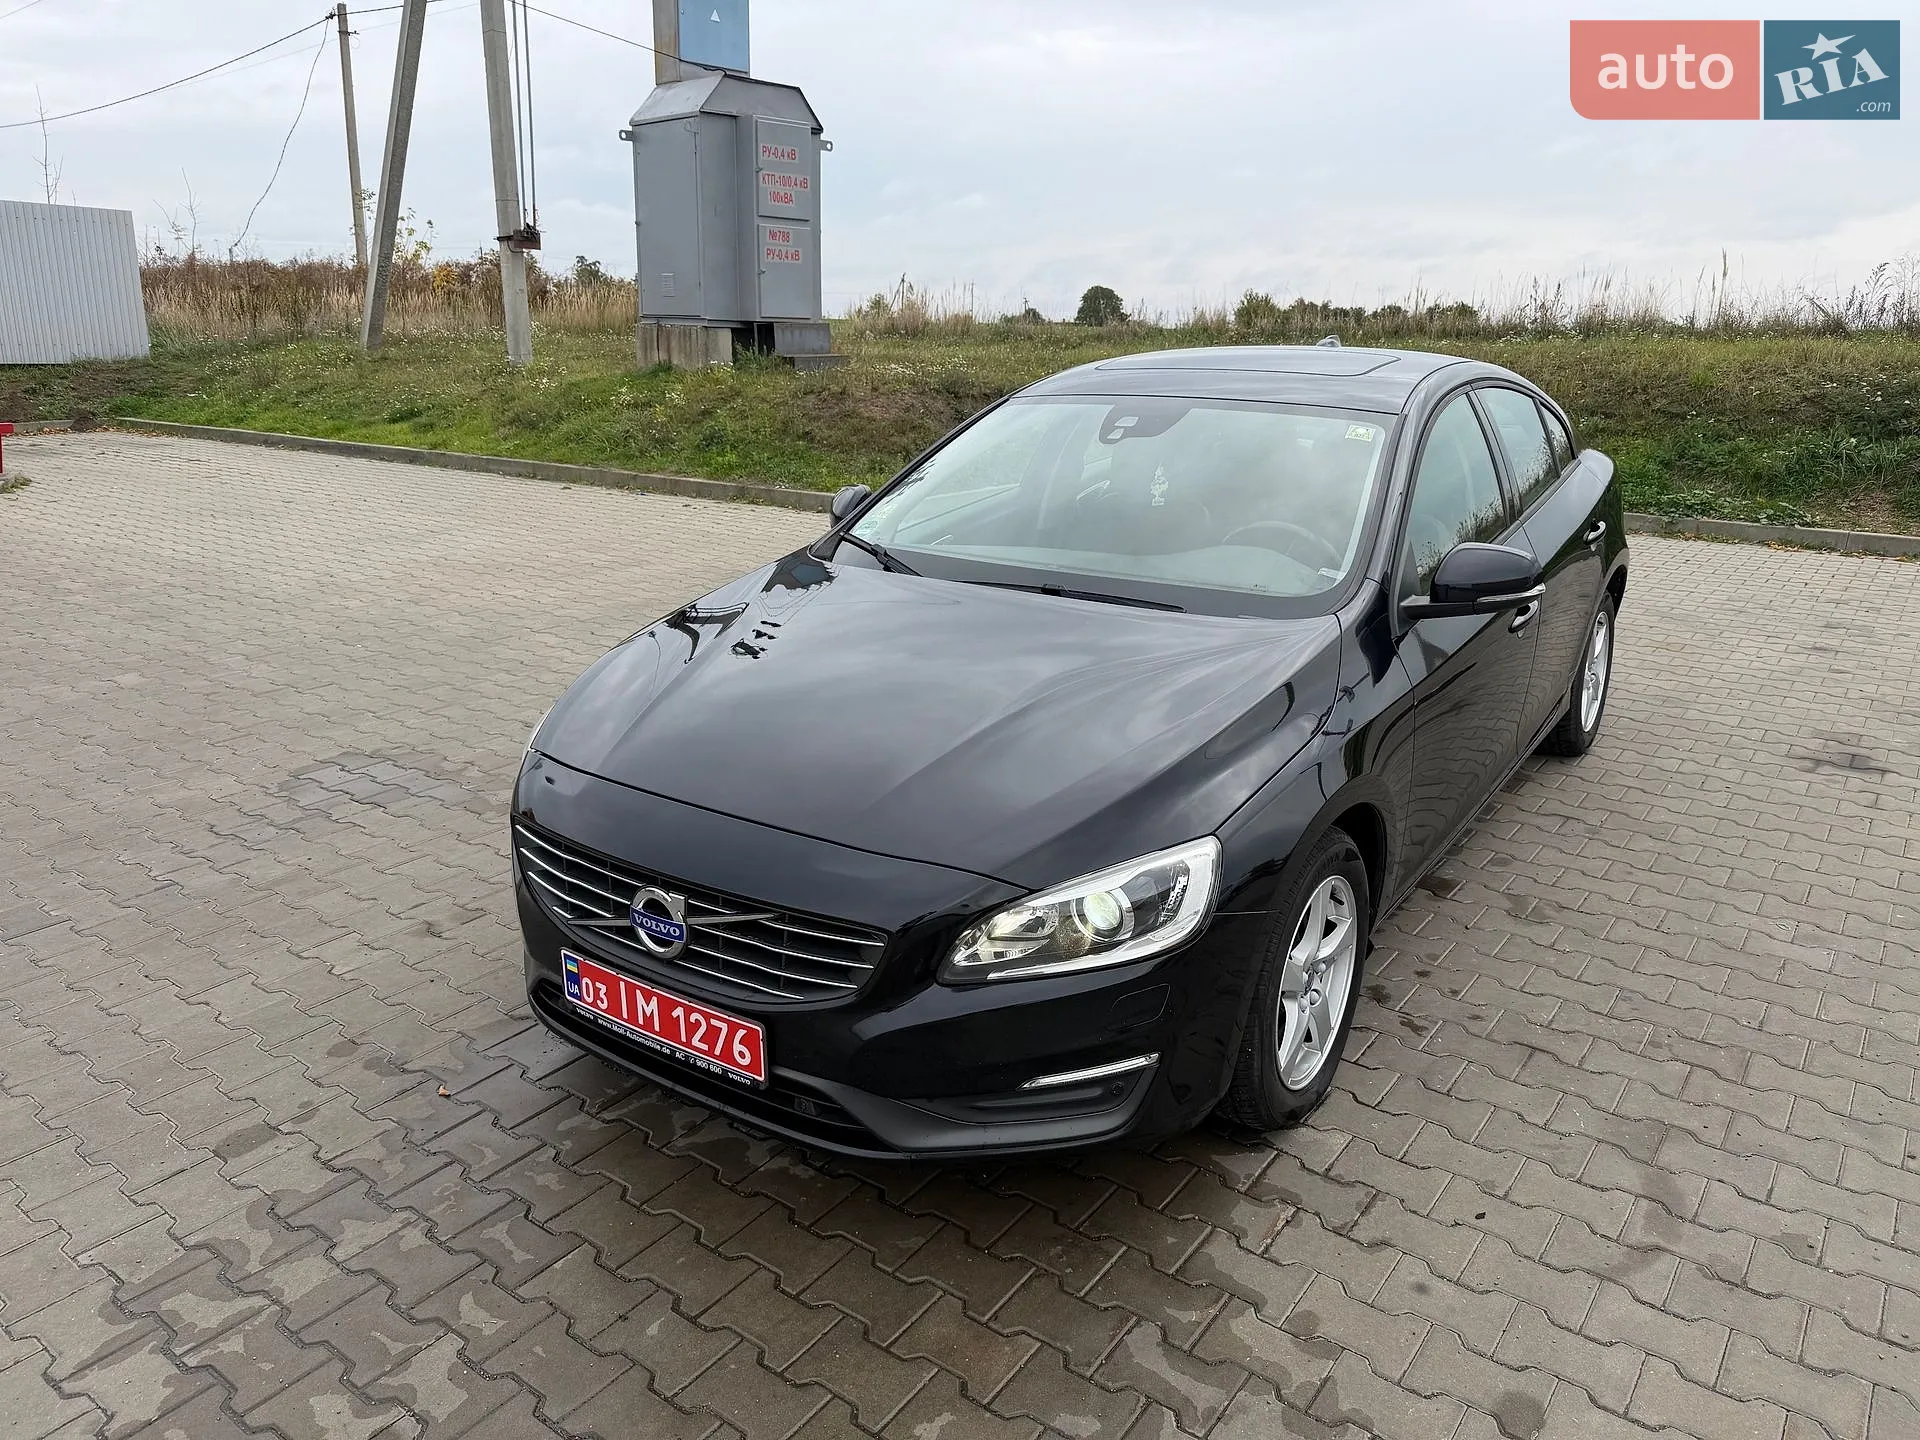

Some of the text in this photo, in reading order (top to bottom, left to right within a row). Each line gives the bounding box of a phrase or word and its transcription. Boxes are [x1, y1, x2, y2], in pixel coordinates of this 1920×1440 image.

[762, 145, 785, 160] РУ-0,4
[766, 248, 789, 263] РУ-0,4
[633, 912, 680, 936] VOLVO
[568, 981, 580, 996] UA
[582, 977, 752, 1066] 03 IM 1276
[728, 1072, 751, 1085] VOLVO
